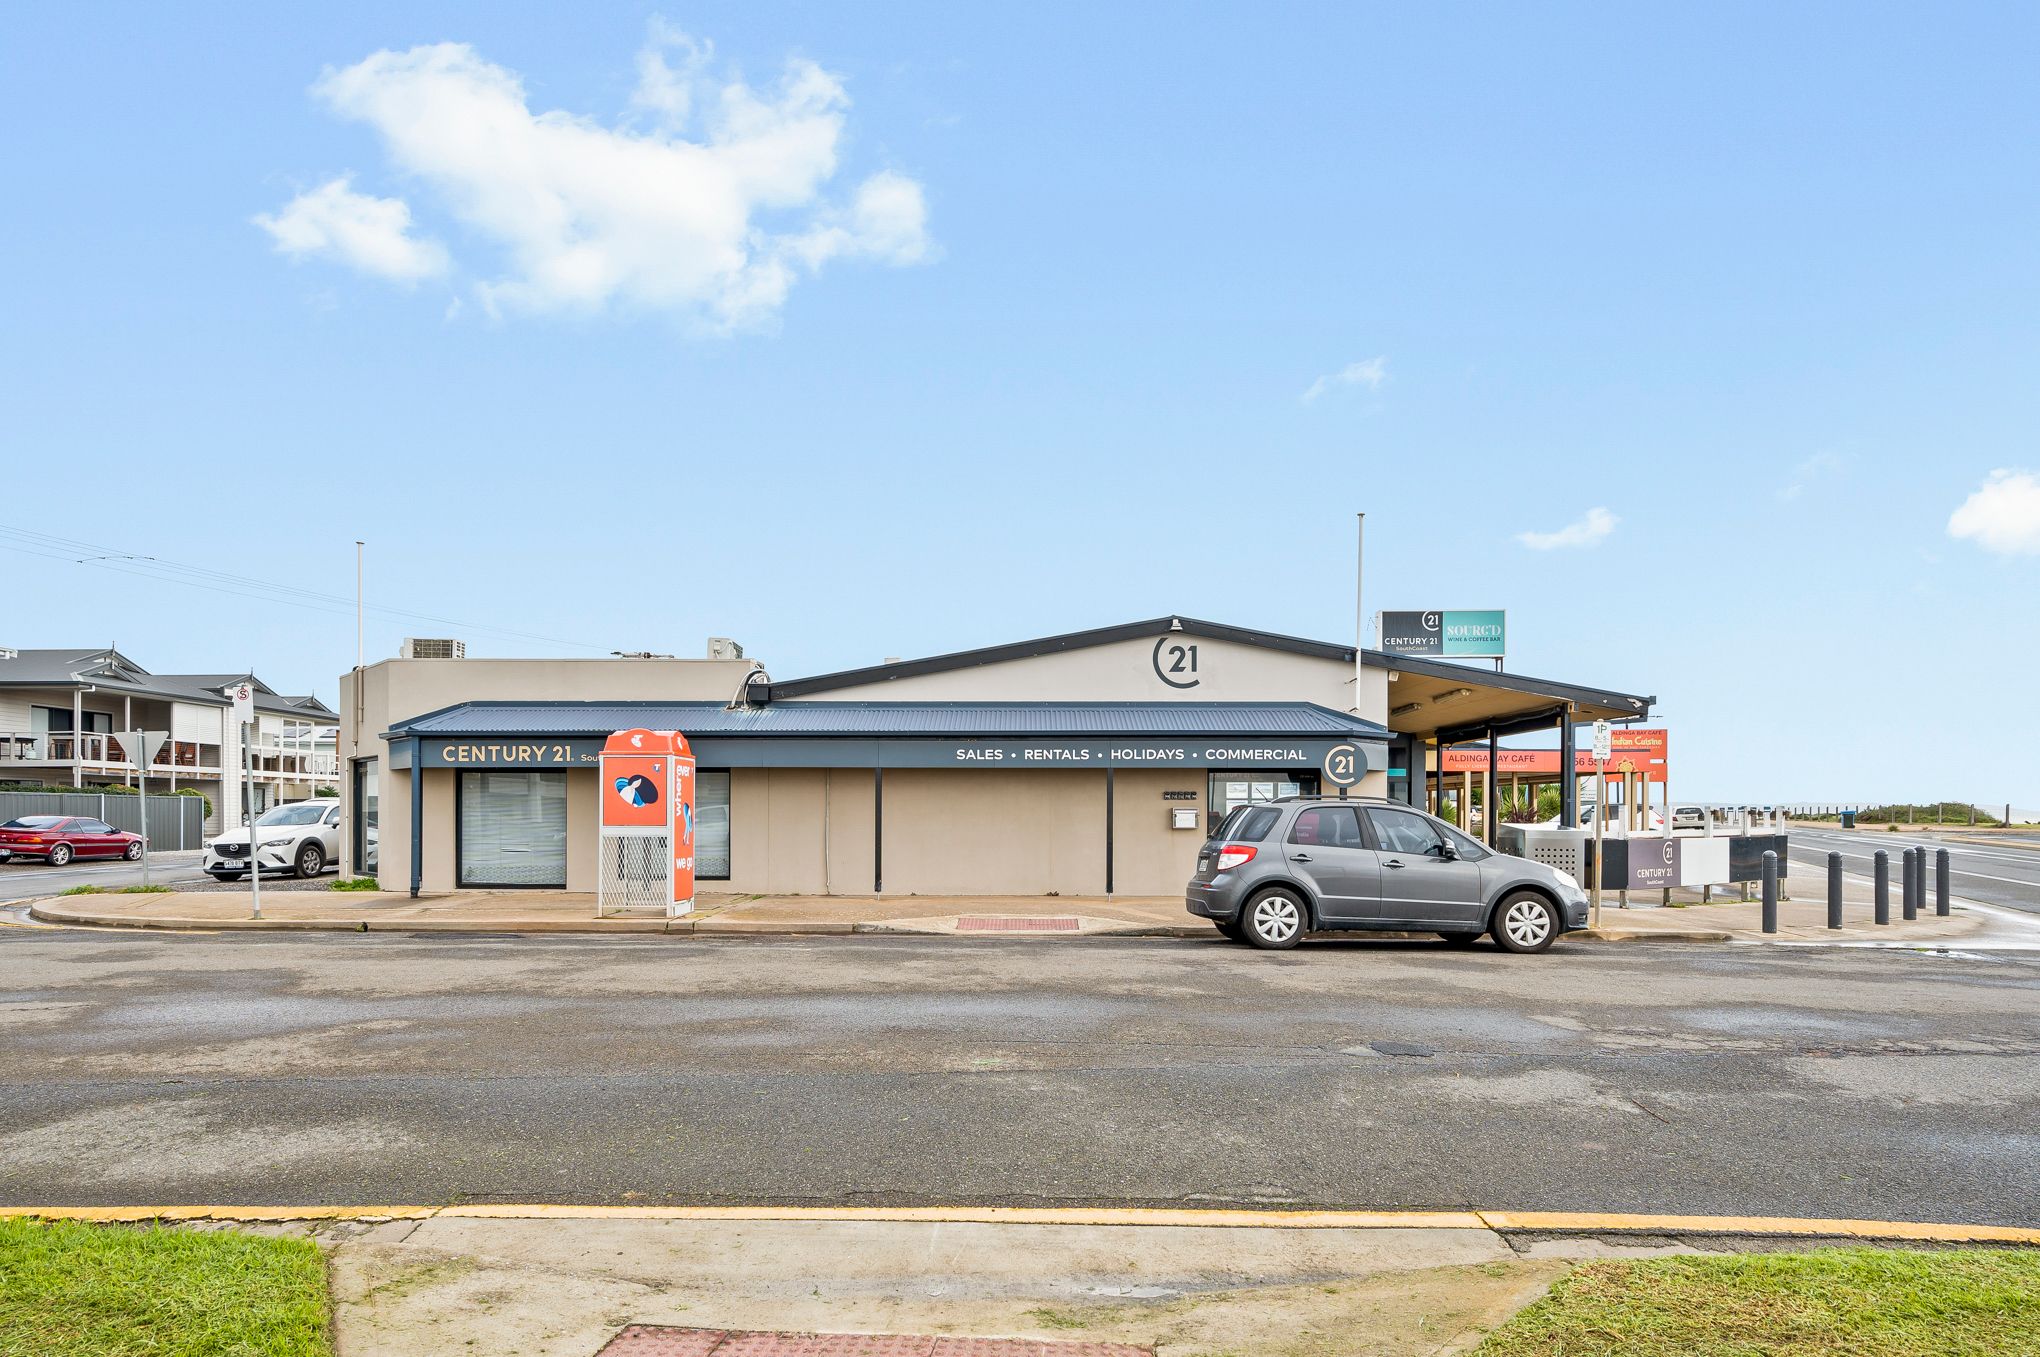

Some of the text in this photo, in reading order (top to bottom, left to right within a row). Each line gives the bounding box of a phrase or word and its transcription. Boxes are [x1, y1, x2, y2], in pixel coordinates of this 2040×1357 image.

[1384, 637, 1438, 645] CENTURY 21
[1634, 736, 1663, 746] Cuisine
[442, 745, 547, 762] CENTURY
[956, 749, 1307, 760] SALES RENTALS HOLIDAYS COMMERCIAL
[1448, 754, 1489, 762] ALDINGA
[1497, 754, 1509, 762] AY
[675, 857, 686, 869] we
[1636, 868, 1666, 878] CENTURY
